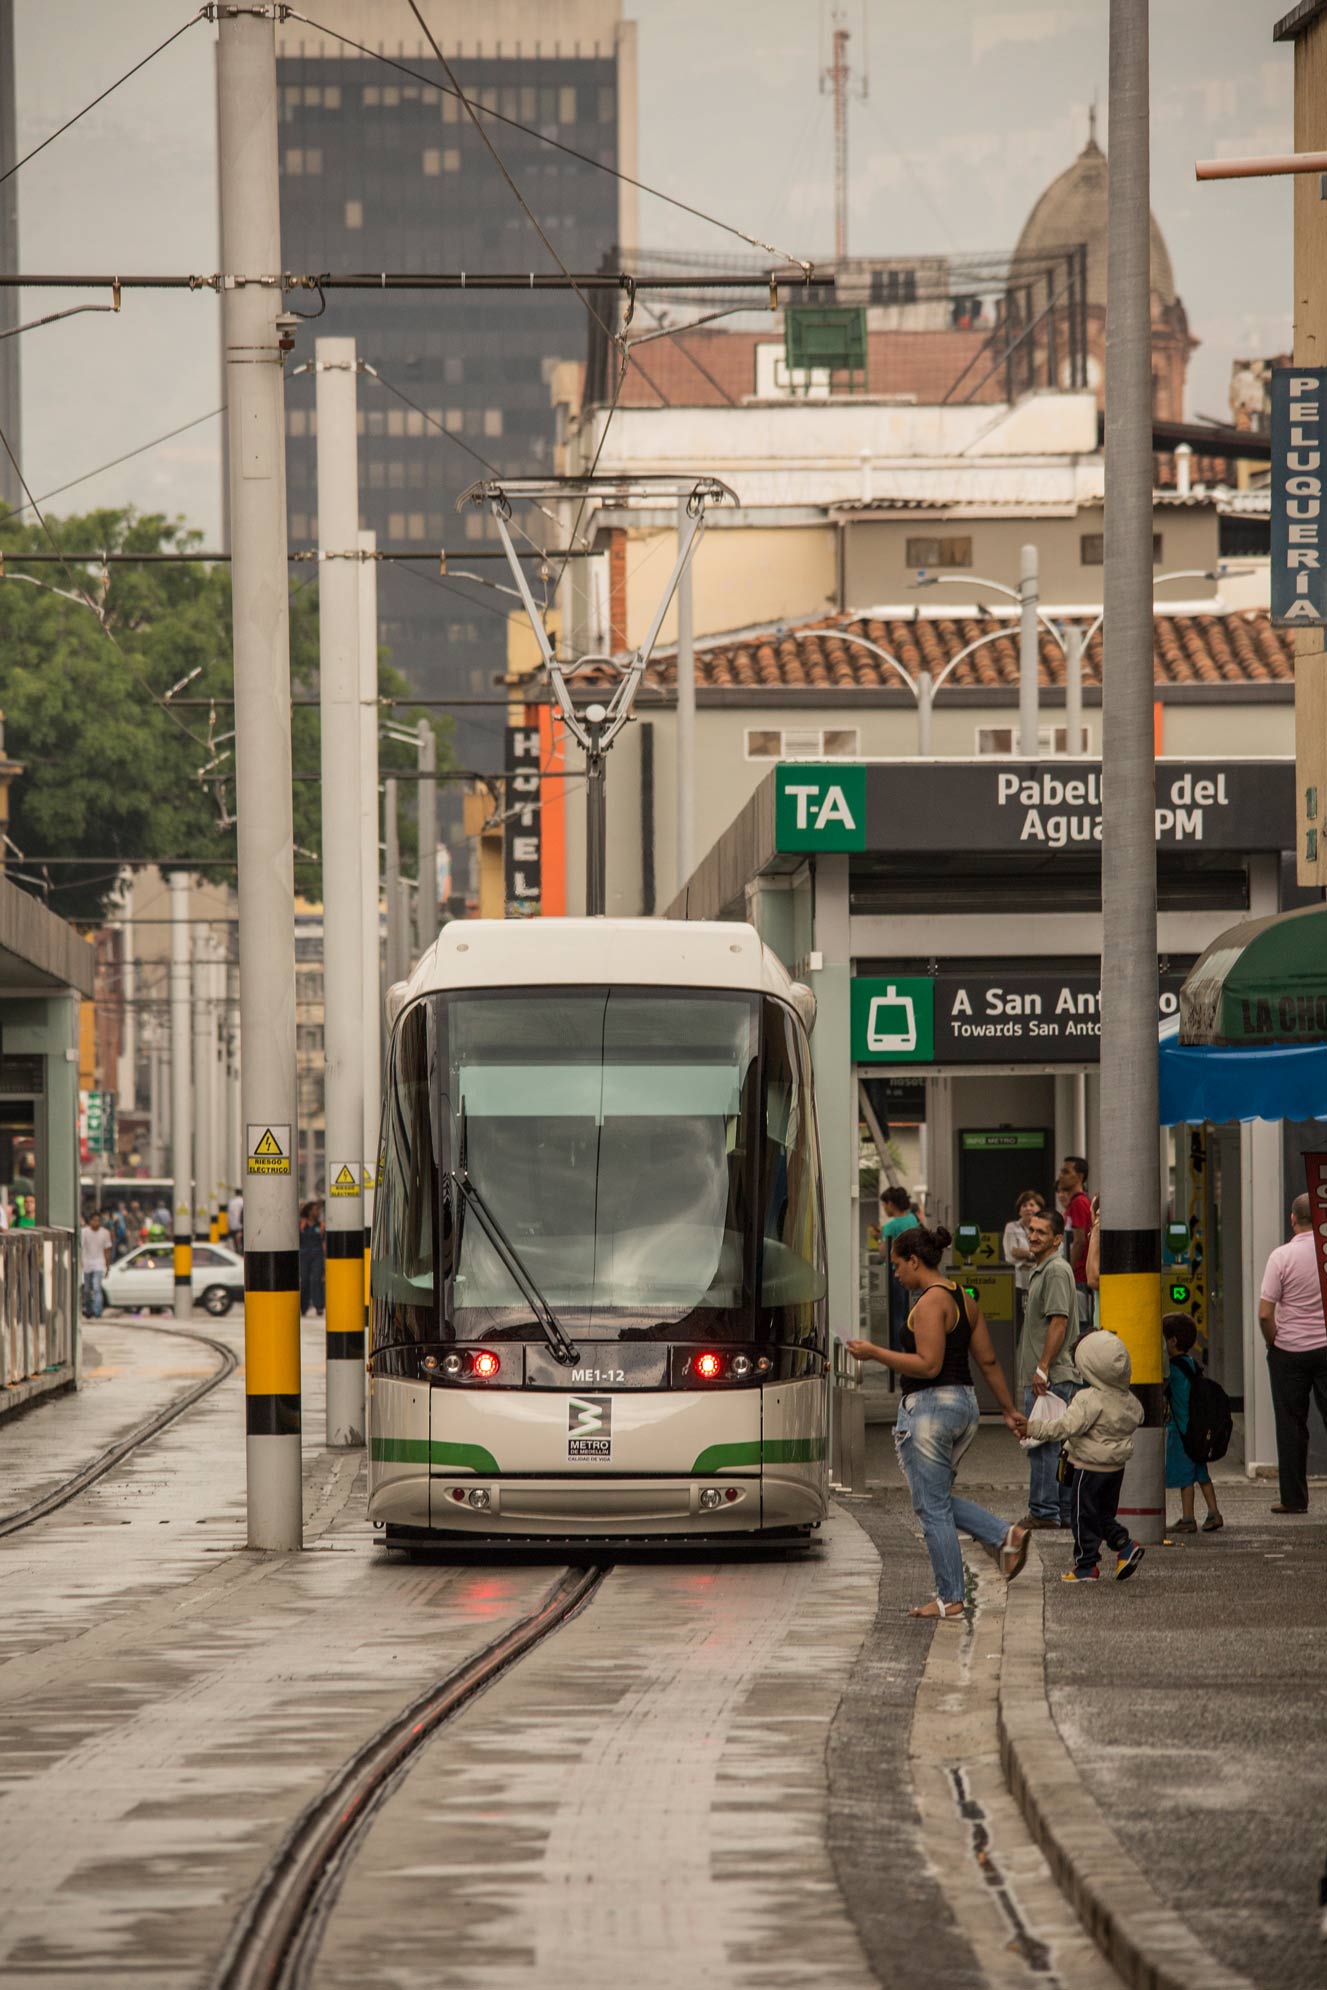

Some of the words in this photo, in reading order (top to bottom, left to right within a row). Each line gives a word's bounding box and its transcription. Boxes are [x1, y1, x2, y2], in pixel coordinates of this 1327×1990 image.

[1284, 377, 1322, 618] PELUQUERÍA
[998, 774, 1103, 806] Pabel
[1170, 774, 1229, 805] del
[513, 732, 540, 897] HOTEL
[951, 989, 973, 1016] A
[985, 988, 1042, 1015] San
[1242, 999, 1274, 1033] LA
[951, 1021, 1023, 1037] Towards
[1029, 1021, 1059, 1036] San
[1065, 1020, 1102, 1036] Anto
[571, 1369, 625, 1382] ME1-12
[570, 1440, 609, 1449] METRO
